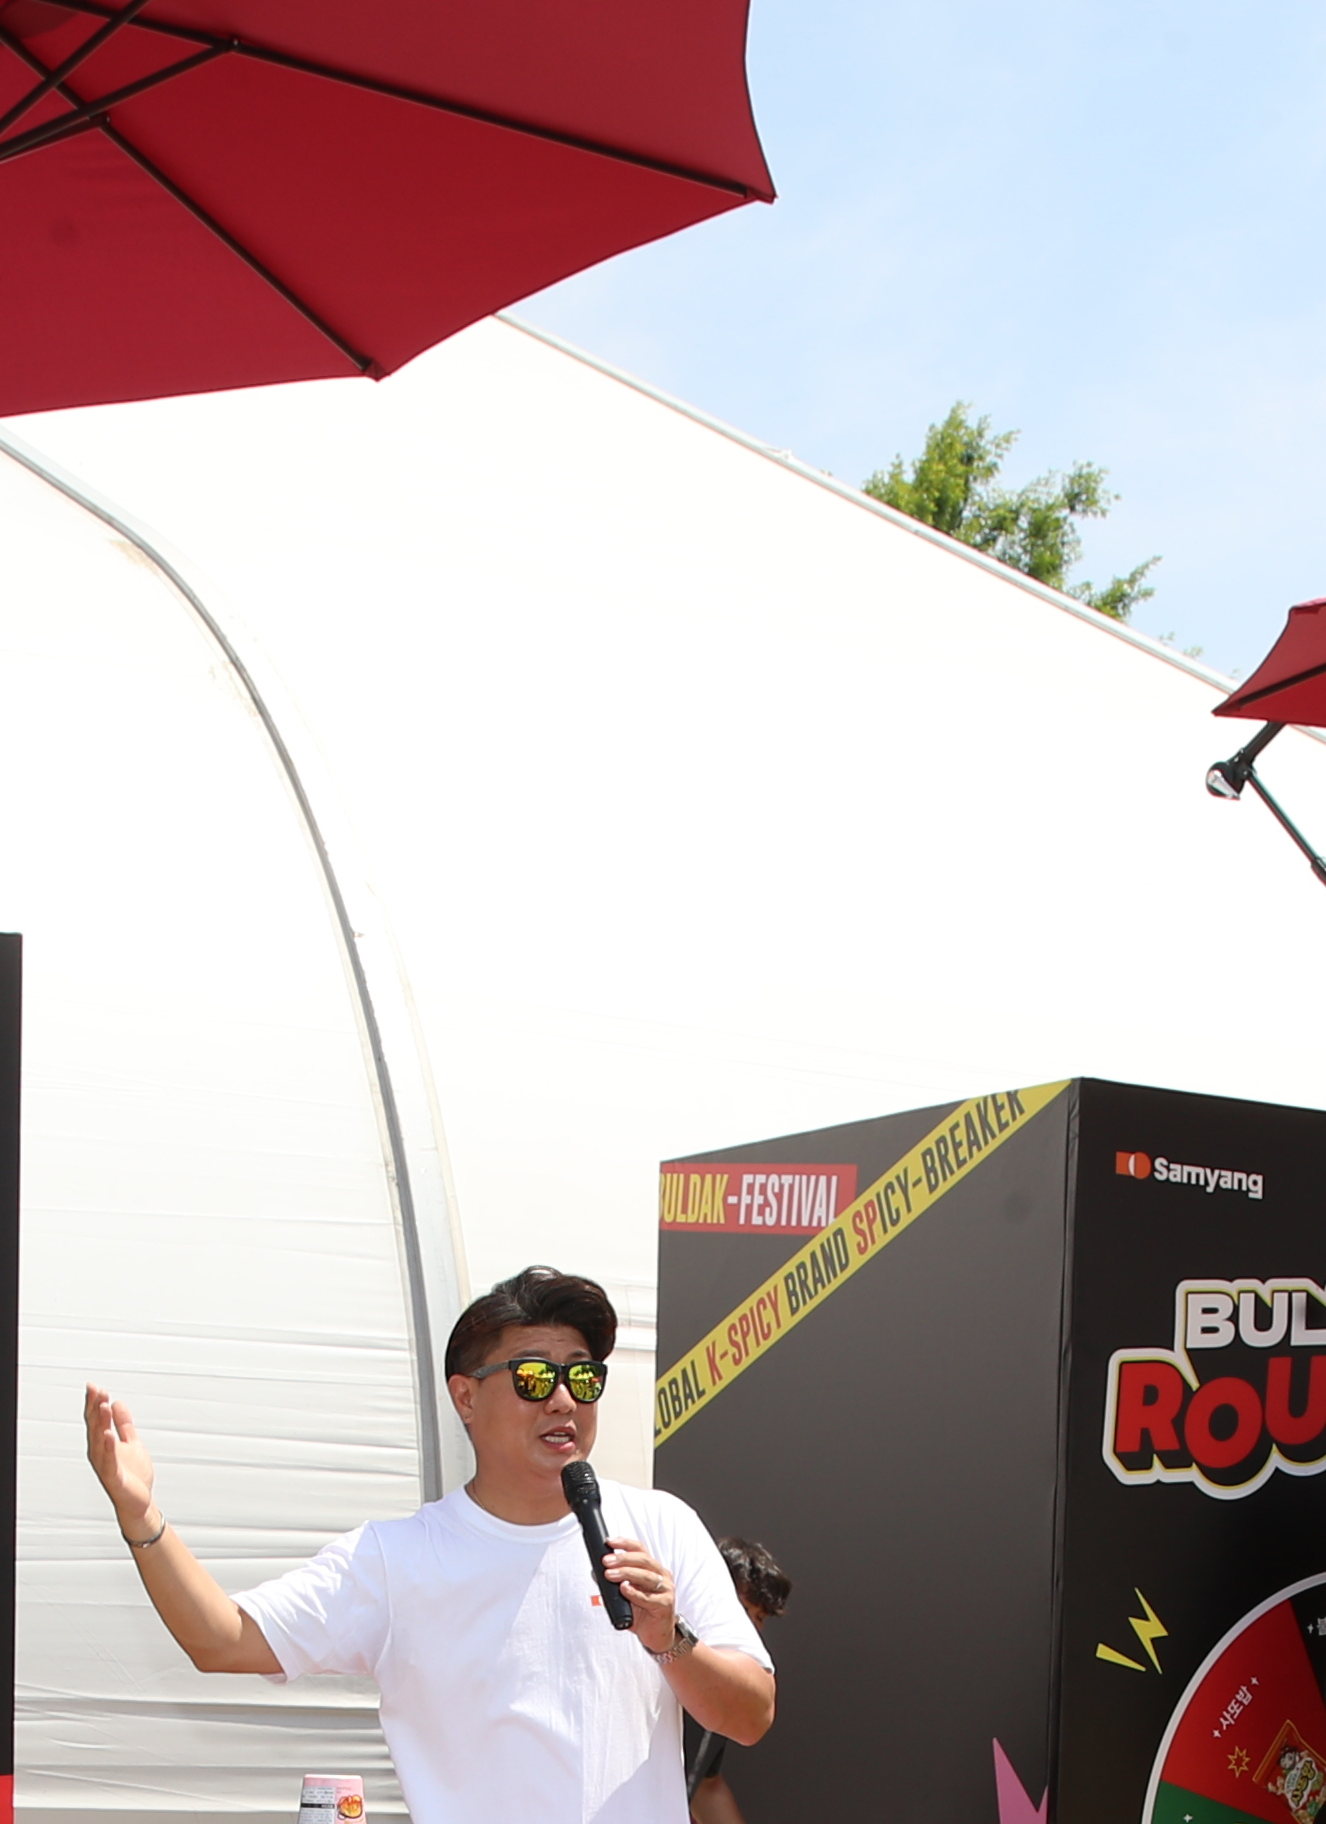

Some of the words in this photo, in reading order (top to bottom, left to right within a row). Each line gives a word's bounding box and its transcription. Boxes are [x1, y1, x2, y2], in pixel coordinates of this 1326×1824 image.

[1153, 1155, 1264, 1199] Samyang
[705, 1283, 784, 1387] K-SPICY
[783, 1227, 851, 1317] BRAND
[1219, 1684, 1253, 1731] 사또밥
